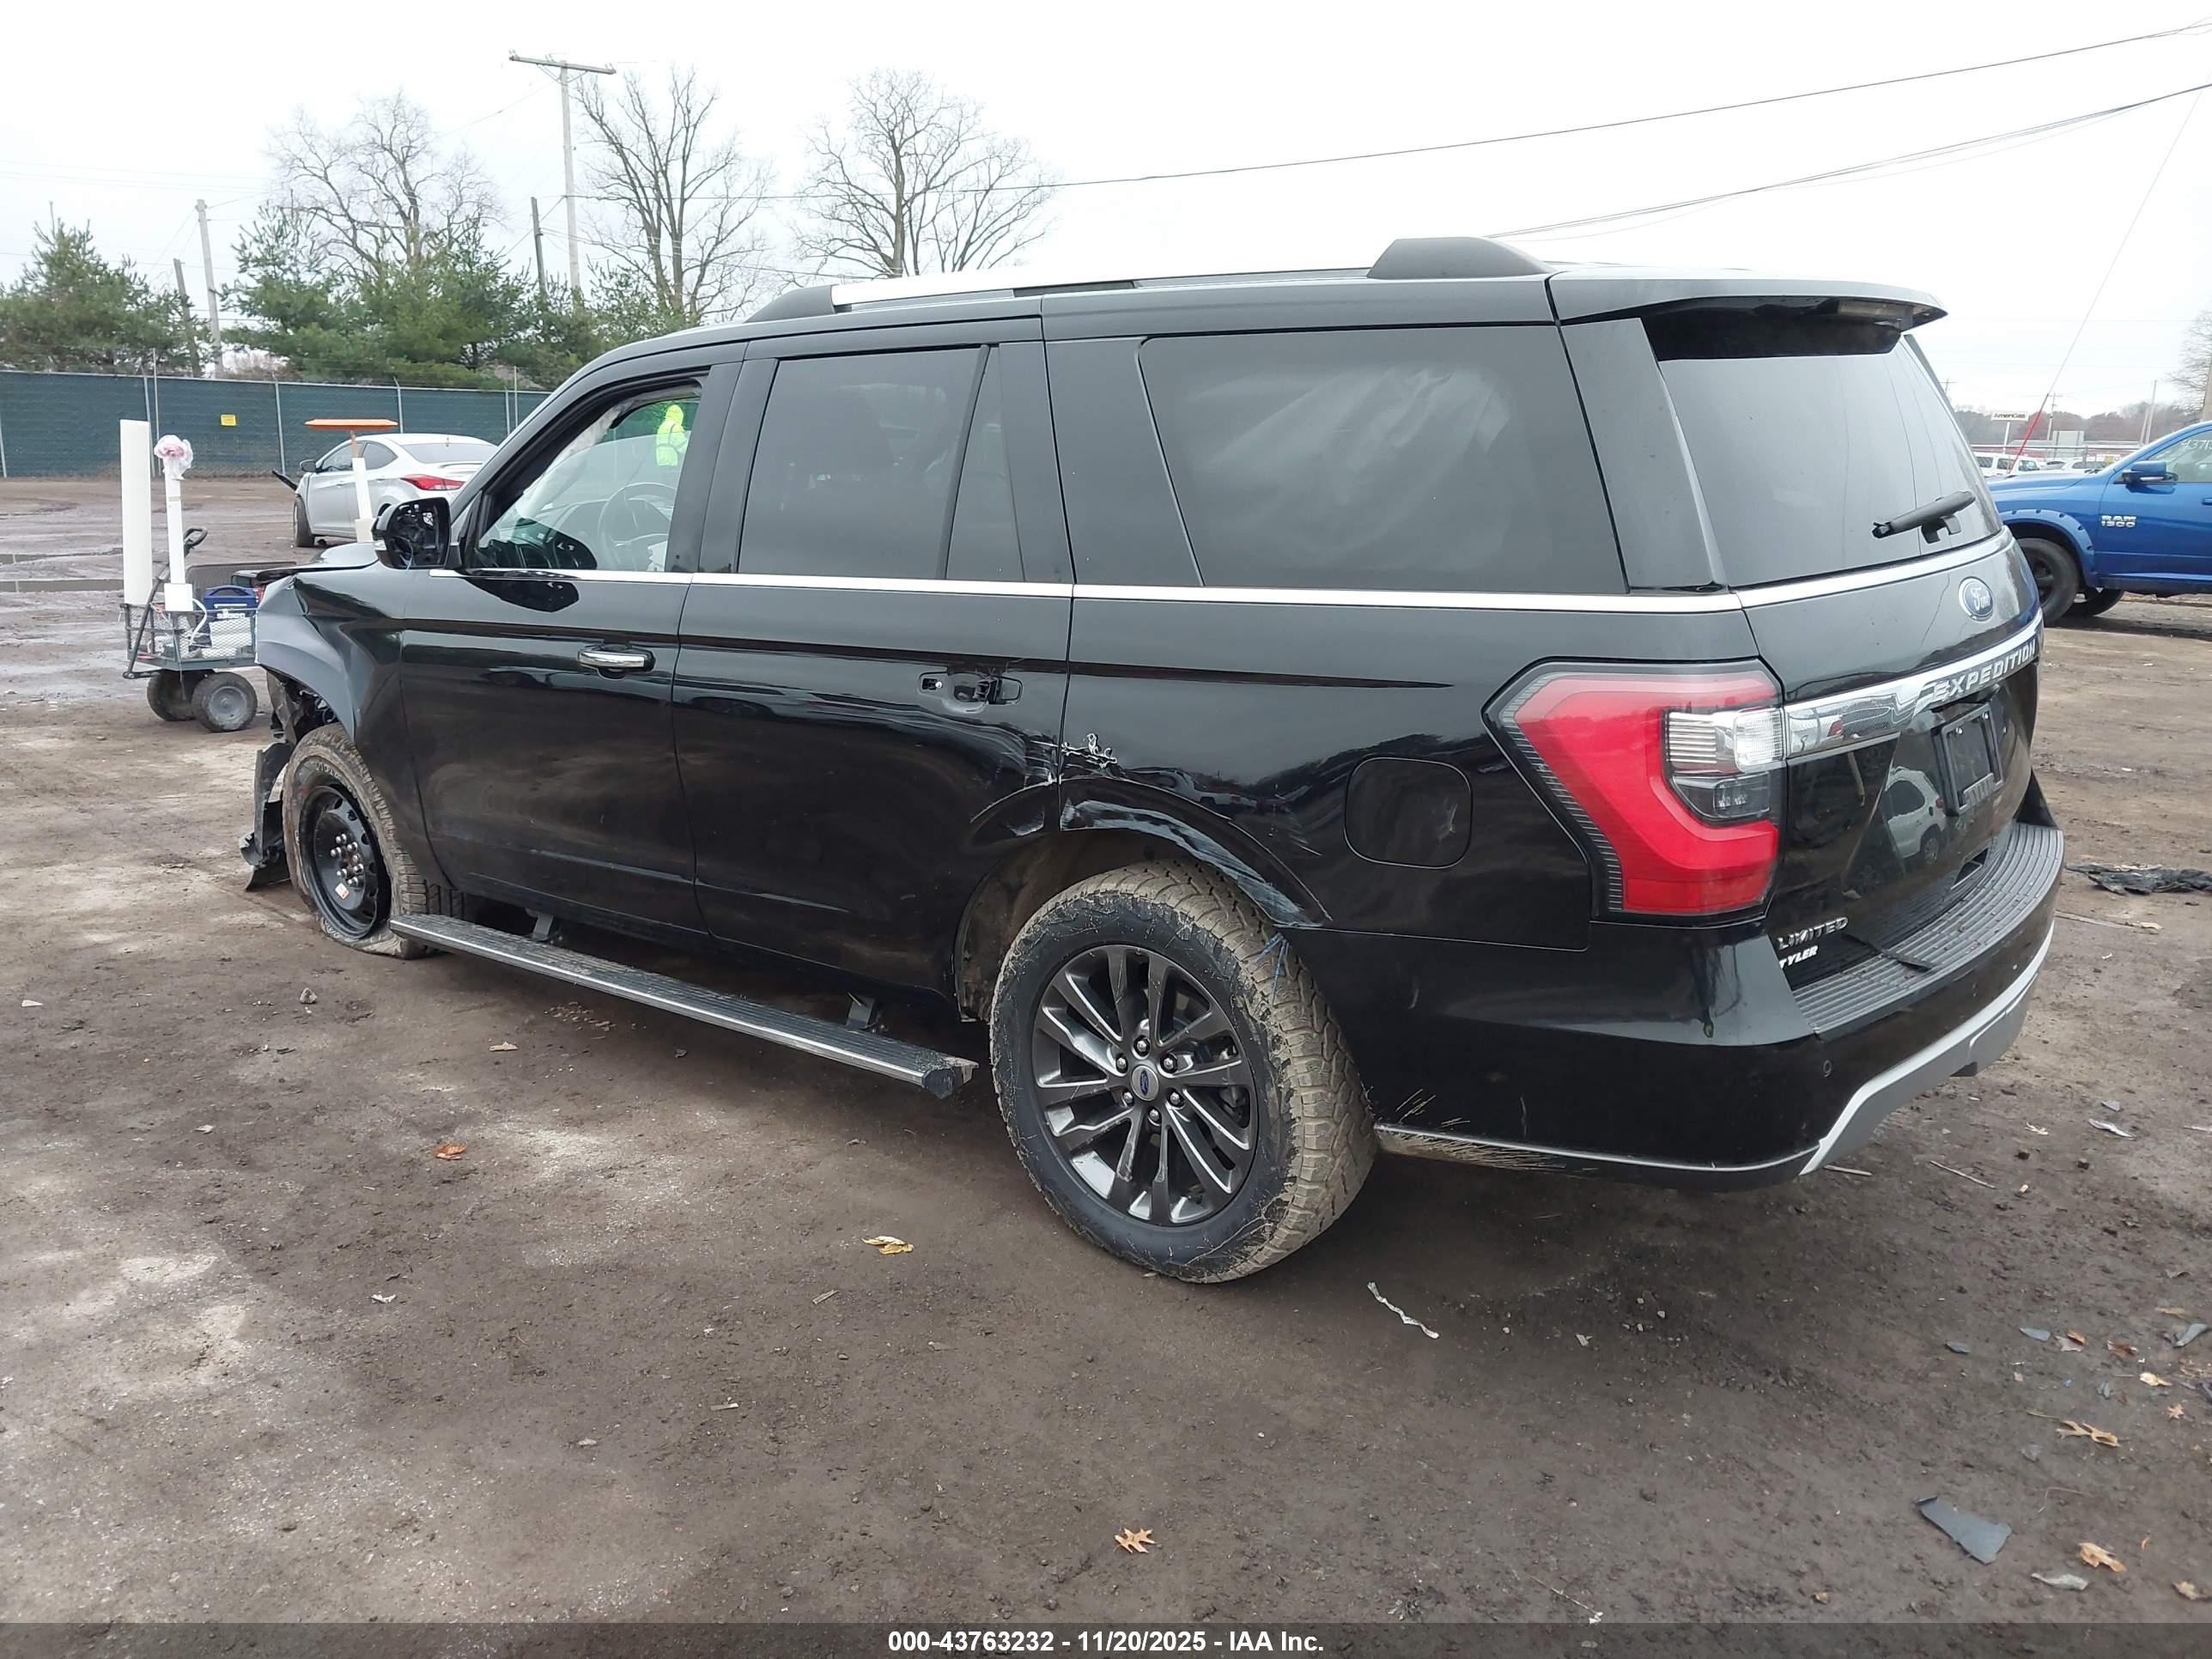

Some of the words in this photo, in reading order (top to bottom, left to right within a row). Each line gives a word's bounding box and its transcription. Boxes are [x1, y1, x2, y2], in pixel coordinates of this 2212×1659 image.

[1970, 586, 1990, 611] Ford
[1932, 638, 2036, 702] EXPEDITION
[1778, 916, 1849, 950] LIMITED
[1778, 945, 1819, 969] TYLER
